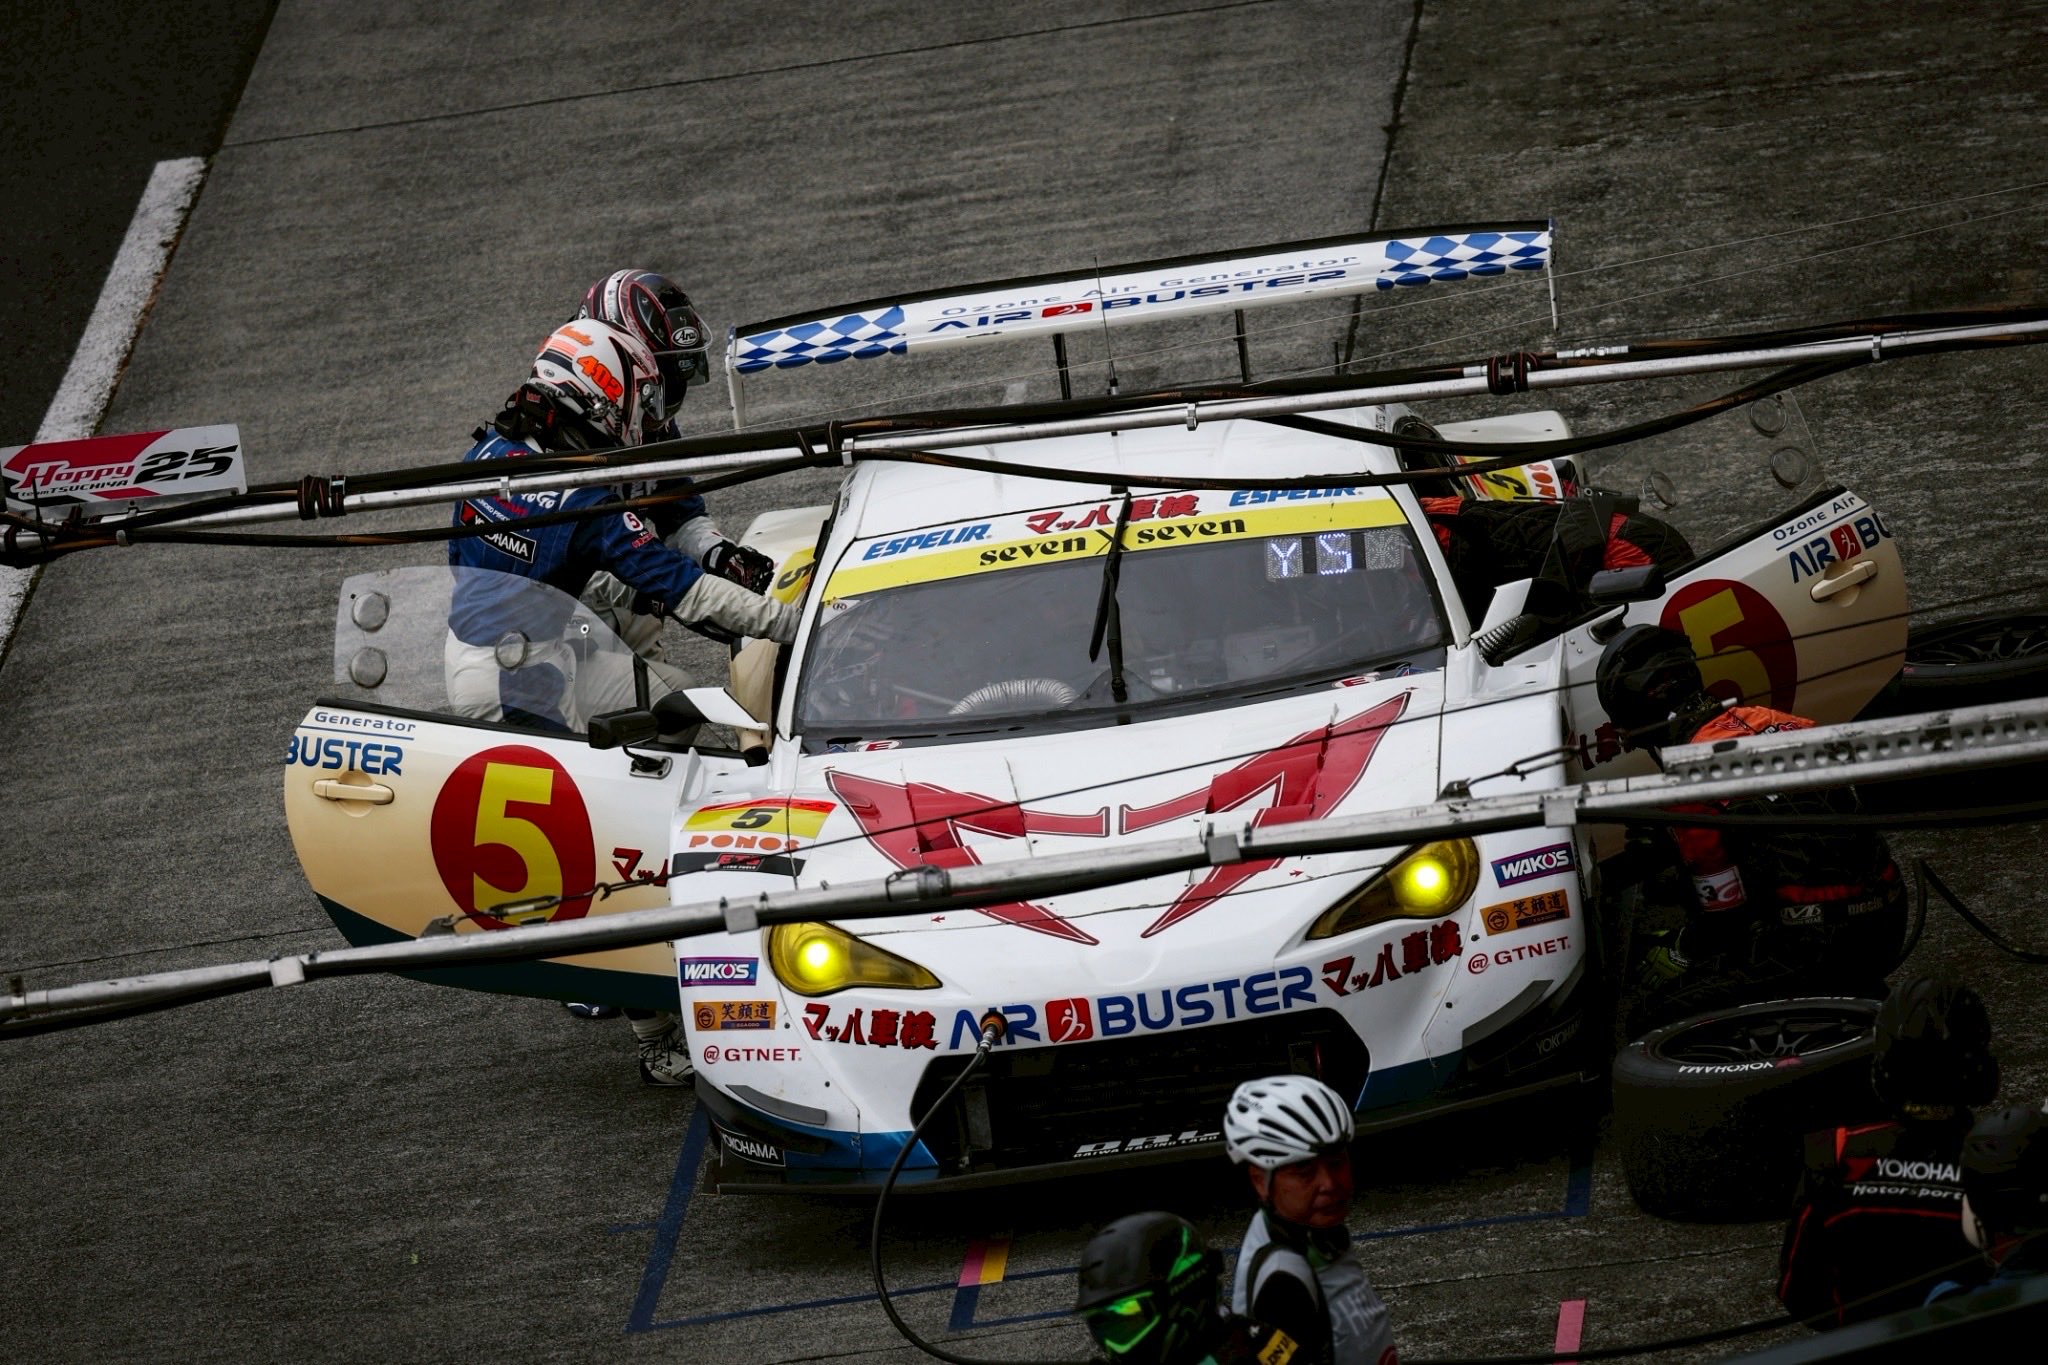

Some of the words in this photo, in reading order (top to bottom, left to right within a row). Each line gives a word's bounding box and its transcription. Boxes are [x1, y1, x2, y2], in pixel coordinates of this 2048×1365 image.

[929, 311, 1032, 332] AIR
[1102, 270, 1346, 310] BUSTER
[942, 296, 1031, 315] Ozone
[1082, 285, 1138, 298] Air
[1160, 255, 1358, 287] Generator
[577, 355, 624, 405] 402
[16, 463, 135, 489] Hoppy
[133, 444, 239, 485] 25
[1773, 512, 1828, 542] Ozone
[1832, 495, 1857, 514] Air
[862, 523, 993, 561] ESPELIR
[979, 536, 1087, 566] seven
[1136, 518, 1248, 545] seven
[1788, 536, 1837, 584] AIR
[1678, 586, 1773, 713] 5
[314, 711, 417, 733] Generator
[730, 808, 782, 829] 5
[473, 761, 565, 926] 5
[689, 834, 800, 851] PONOS
[612, 847, 669, 888] マッ
[1494, 936, 1569, 965] GTNET
[949, 1004, 1041, 1050] AR
[1097, 966, 1317, 1037] BUSTER
[724, 1048, 800, 1061] GTNET
[1678, 1061, 1775, 1074] YOKOHAMA
[1072, 1147, 1120, 1159] DAIWA
